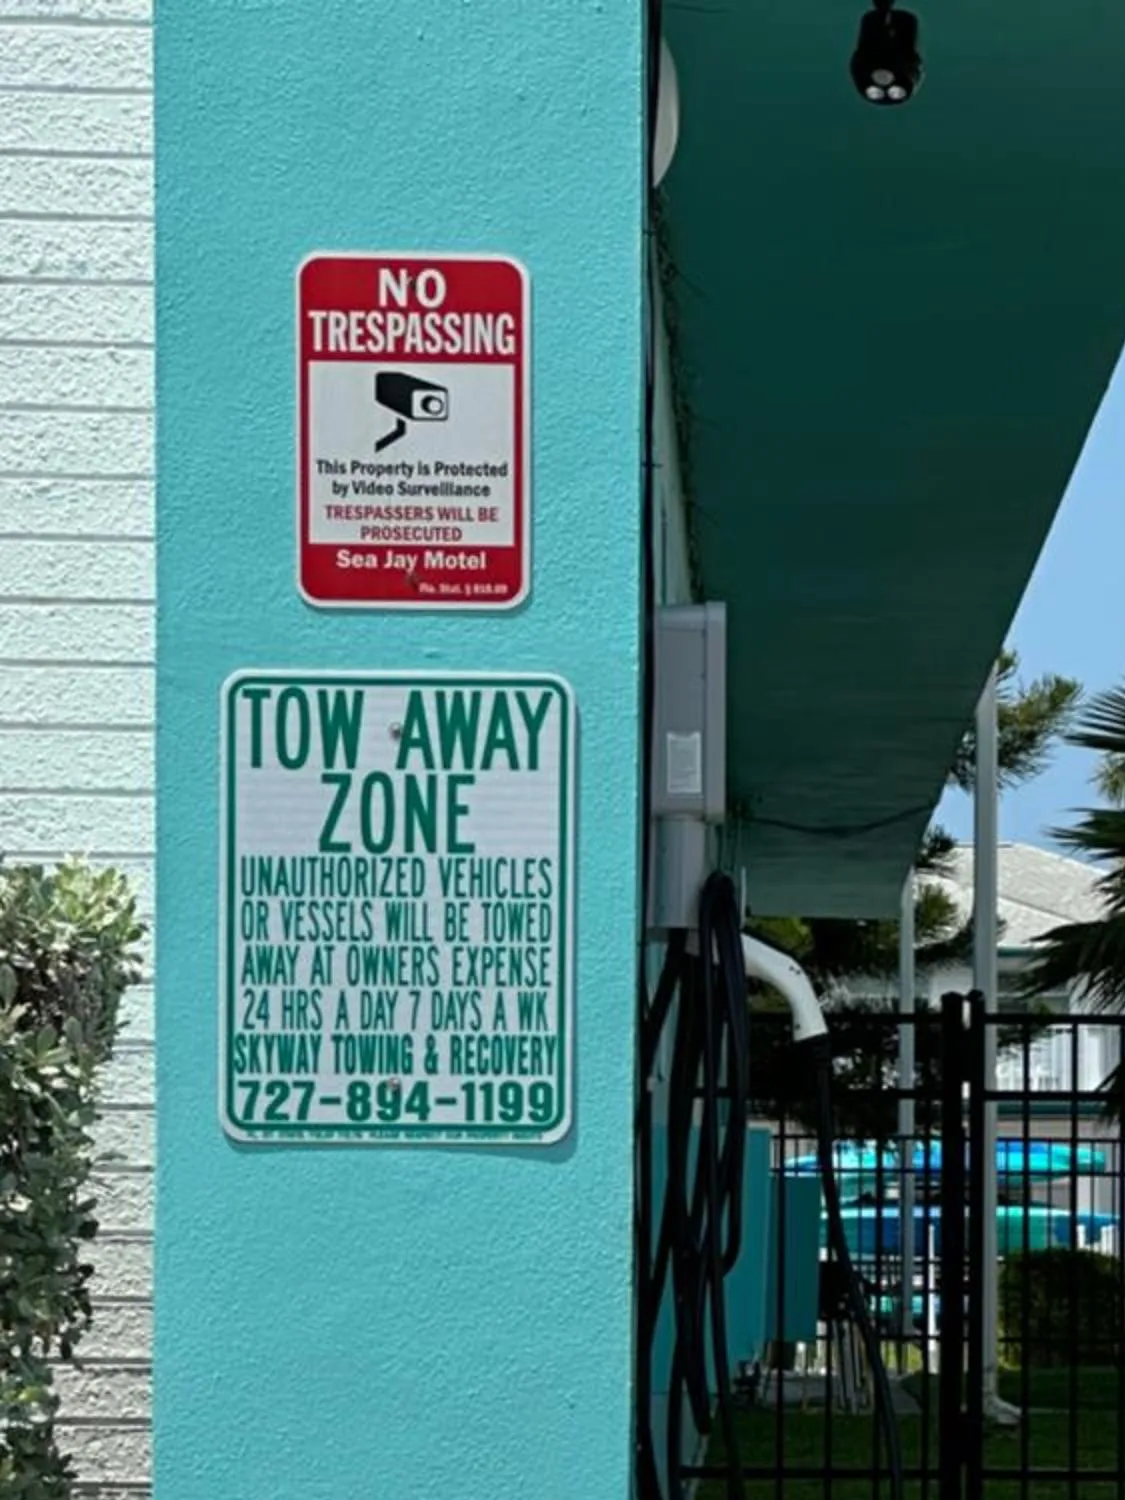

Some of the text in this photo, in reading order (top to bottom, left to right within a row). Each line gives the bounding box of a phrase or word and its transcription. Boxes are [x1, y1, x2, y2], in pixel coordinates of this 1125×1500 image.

[378, 268, 446, 309] NO
[308, 310, 515, 355] TRESPASSING
[317, 460, 508, 478] This Property is Protected
[332, 481, 491, 498] by Video Surveillance
[325, 504, 499, 522] TRESPASSERS WILL BE
[360, 526, 462, 542] PROSECUTED
[336, 549, 487, 572] Sea Jay Motel
[242, 687, 554, 771] TOW AWAY
[318, 772, 476, 854] ZONE
[241, 856, 553, 899] UNAUTHORIZED VEHICLES
[241, 900, 552, 943] OR VESSELS WILL BE TOWED
[241, 945, 552, 988] AWAY AT OWNERS EXPENSE
[242, 990, 549, 1033] 24 HRS A DAY 7 DAYS A WK
[234, 1034, 557, 1076] SKYWAY TOWING & RECOVERY
[237, 1081, 555, 1123] 727-894-1199
